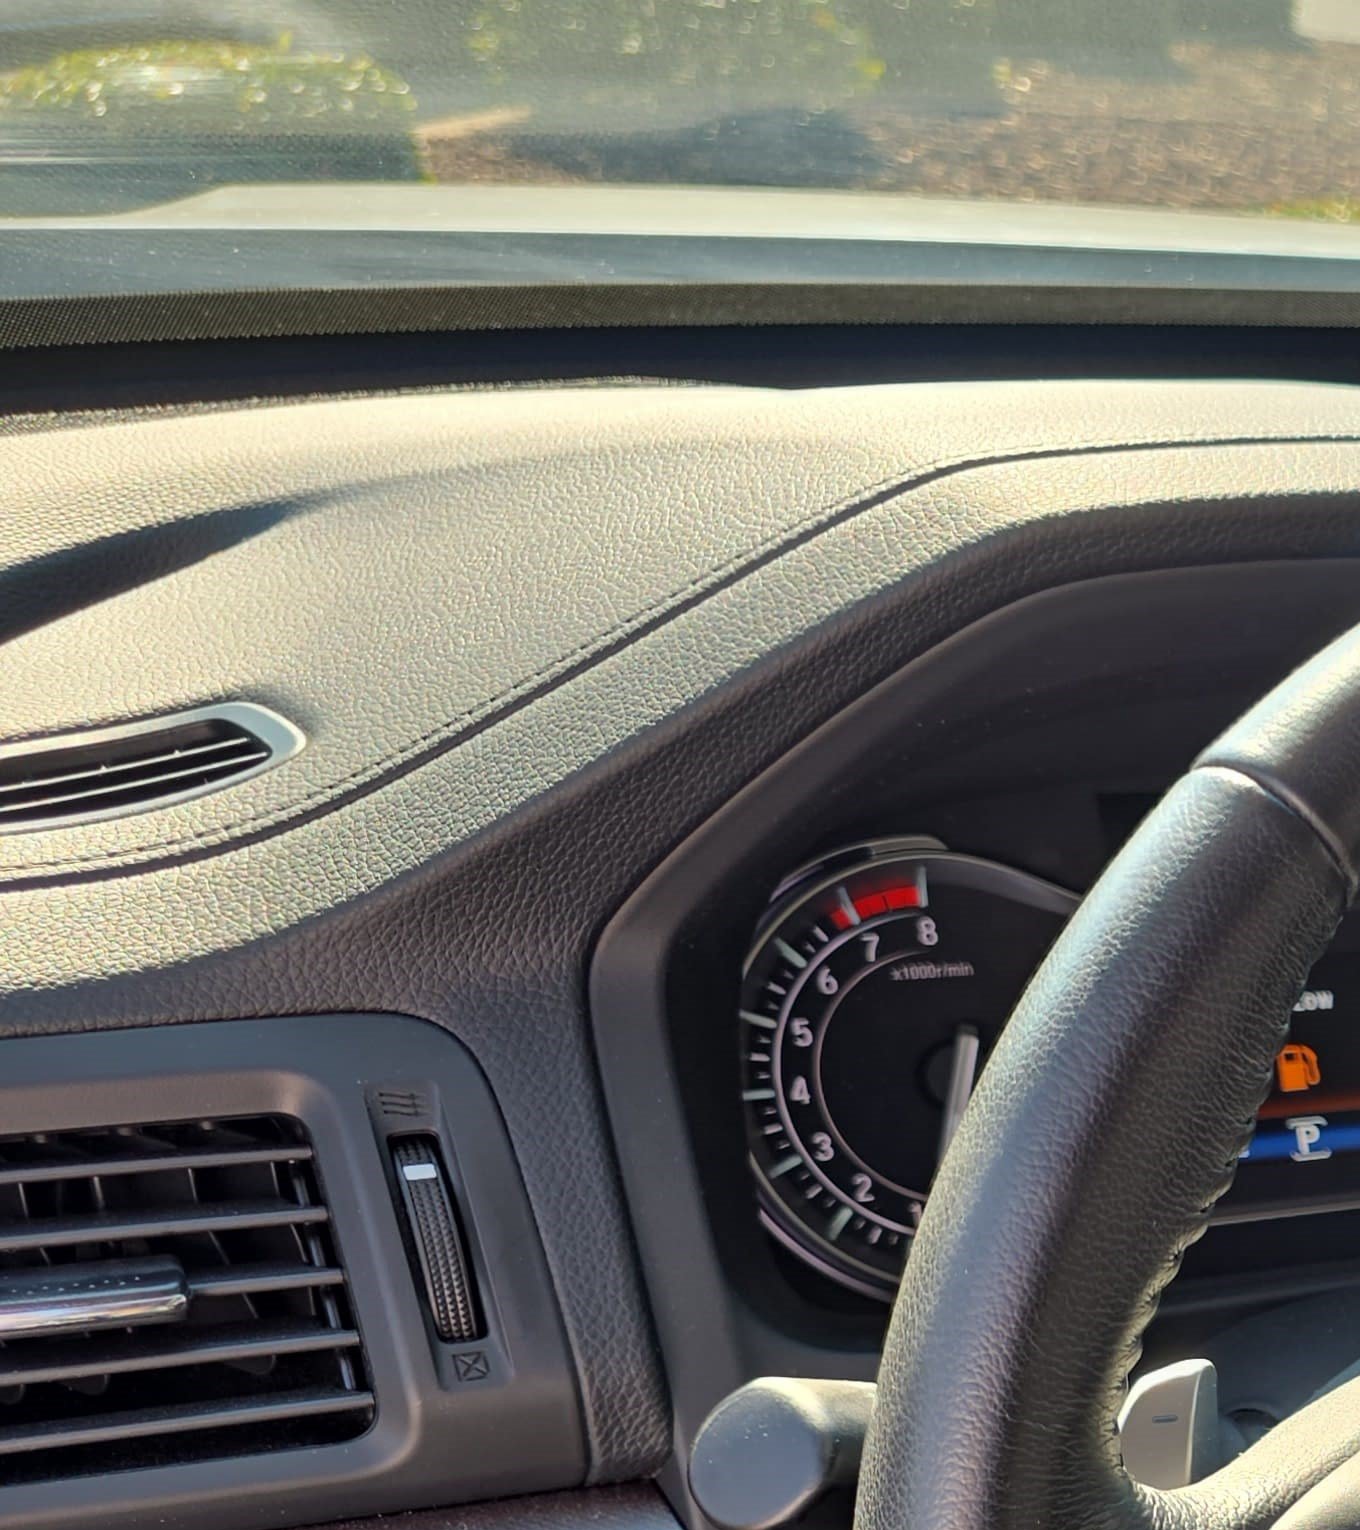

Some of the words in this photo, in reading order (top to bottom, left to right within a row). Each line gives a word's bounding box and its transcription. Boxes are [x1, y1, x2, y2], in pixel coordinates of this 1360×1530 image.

[917, 916, 939, 946] 8
[859, 933, 880, 963] 7
[816, 968, 839, 996] 6
[790, 1018, 814, 1046] 5
[789, 1076, 812, 1105] 4
[812, 1131, 836, 1161] 3
[851, 1173, 876, 1202] 2
